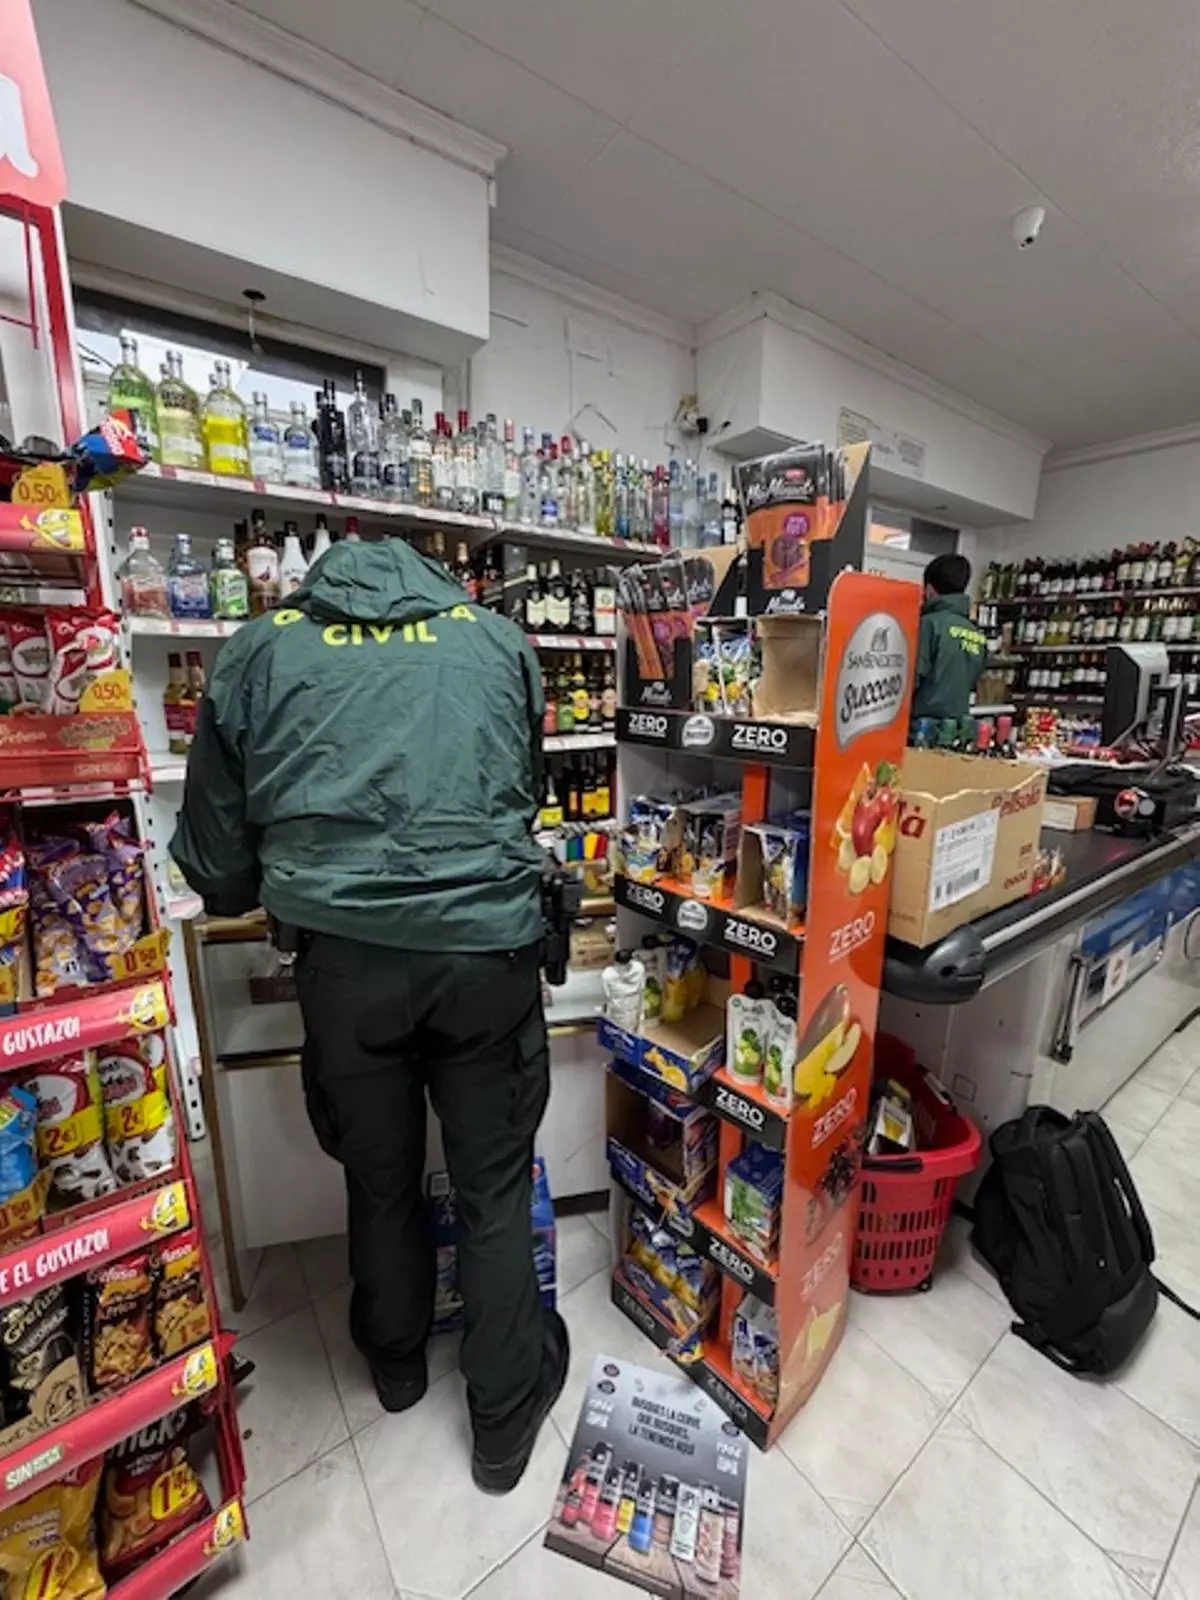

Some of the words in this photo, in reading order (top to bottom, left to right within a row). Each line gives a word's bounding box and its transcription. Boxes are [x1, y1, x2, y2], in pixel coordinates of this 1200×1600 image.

[322, 620, 438, 646] CIVIL
[628, 713, 668, 733] ZERO
[732, 724, 788, 748] ZERO
[626, 881, 665, 908] ZERO
[724, 918, 777, 951] ZERO
[829, 910, 876, 955] ZERO
[3, 1016, 81, 1055] GUSTAZO!
[716, 1086, 765, 1126] ZERO
[813, 1087, 857, 1143] ZERO
[13, 1259, 34, 1288] EL
[36, 1228, 109, 1278] GUSTAZO!
[709, 1236, 755, 1282] ZERO
